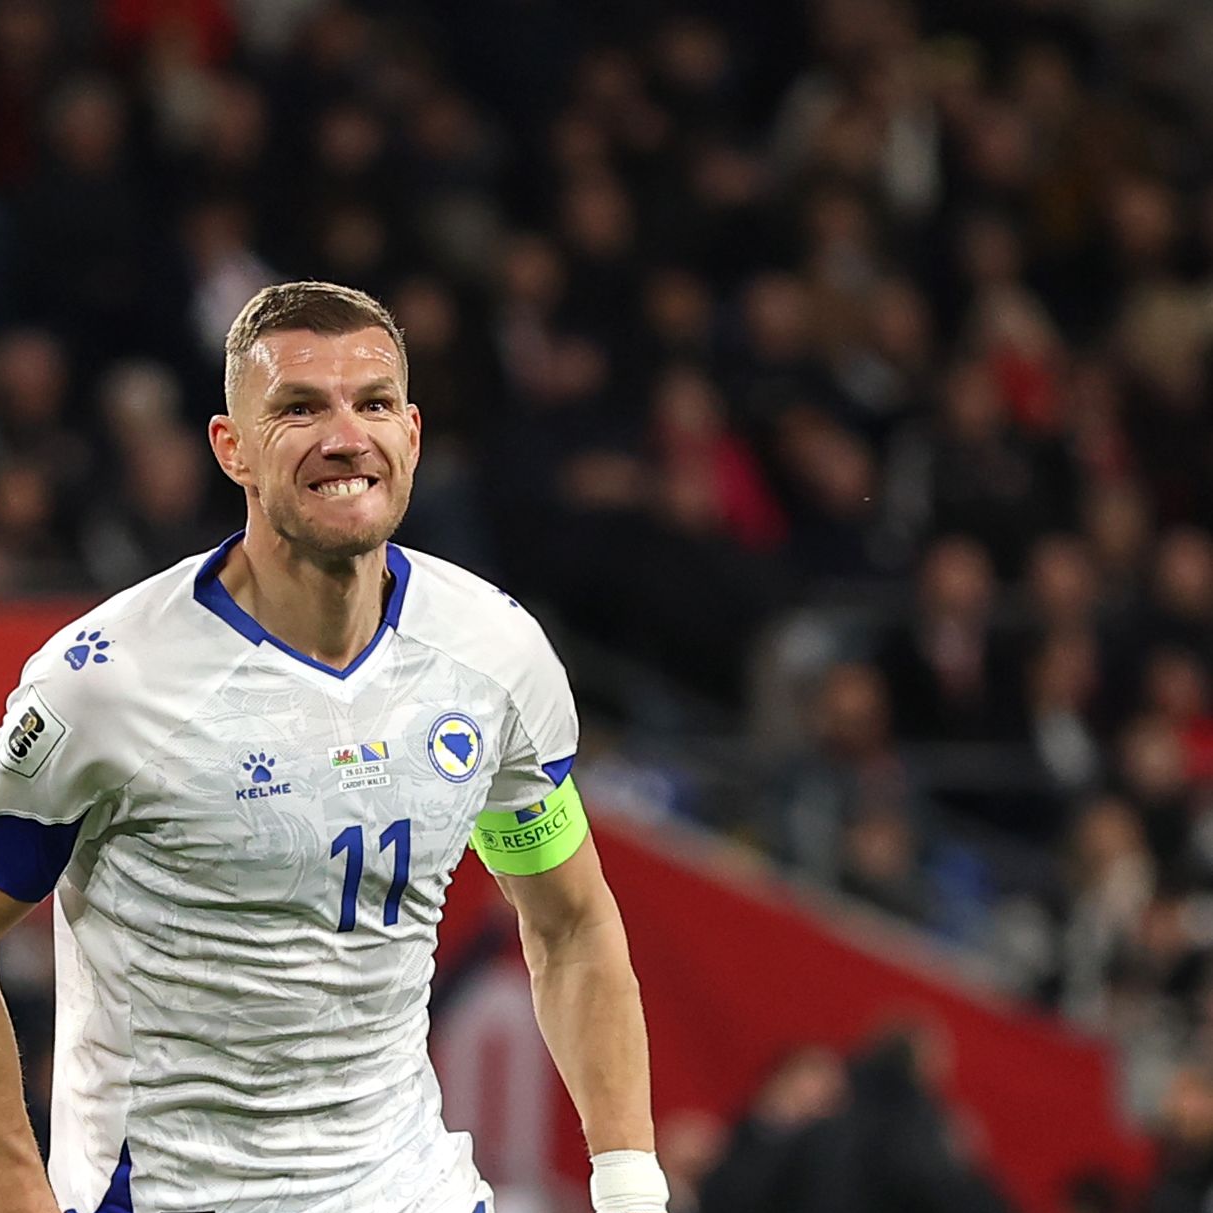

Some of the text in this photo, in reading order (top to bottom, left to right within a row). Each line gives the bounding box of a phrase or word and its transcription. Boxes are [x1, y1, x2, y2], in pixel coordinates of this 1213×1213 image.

[235, 783, 292, 800] KELME
[502, 806, 568, 848] RESPECT
[330, 818, 411, 933] 11
